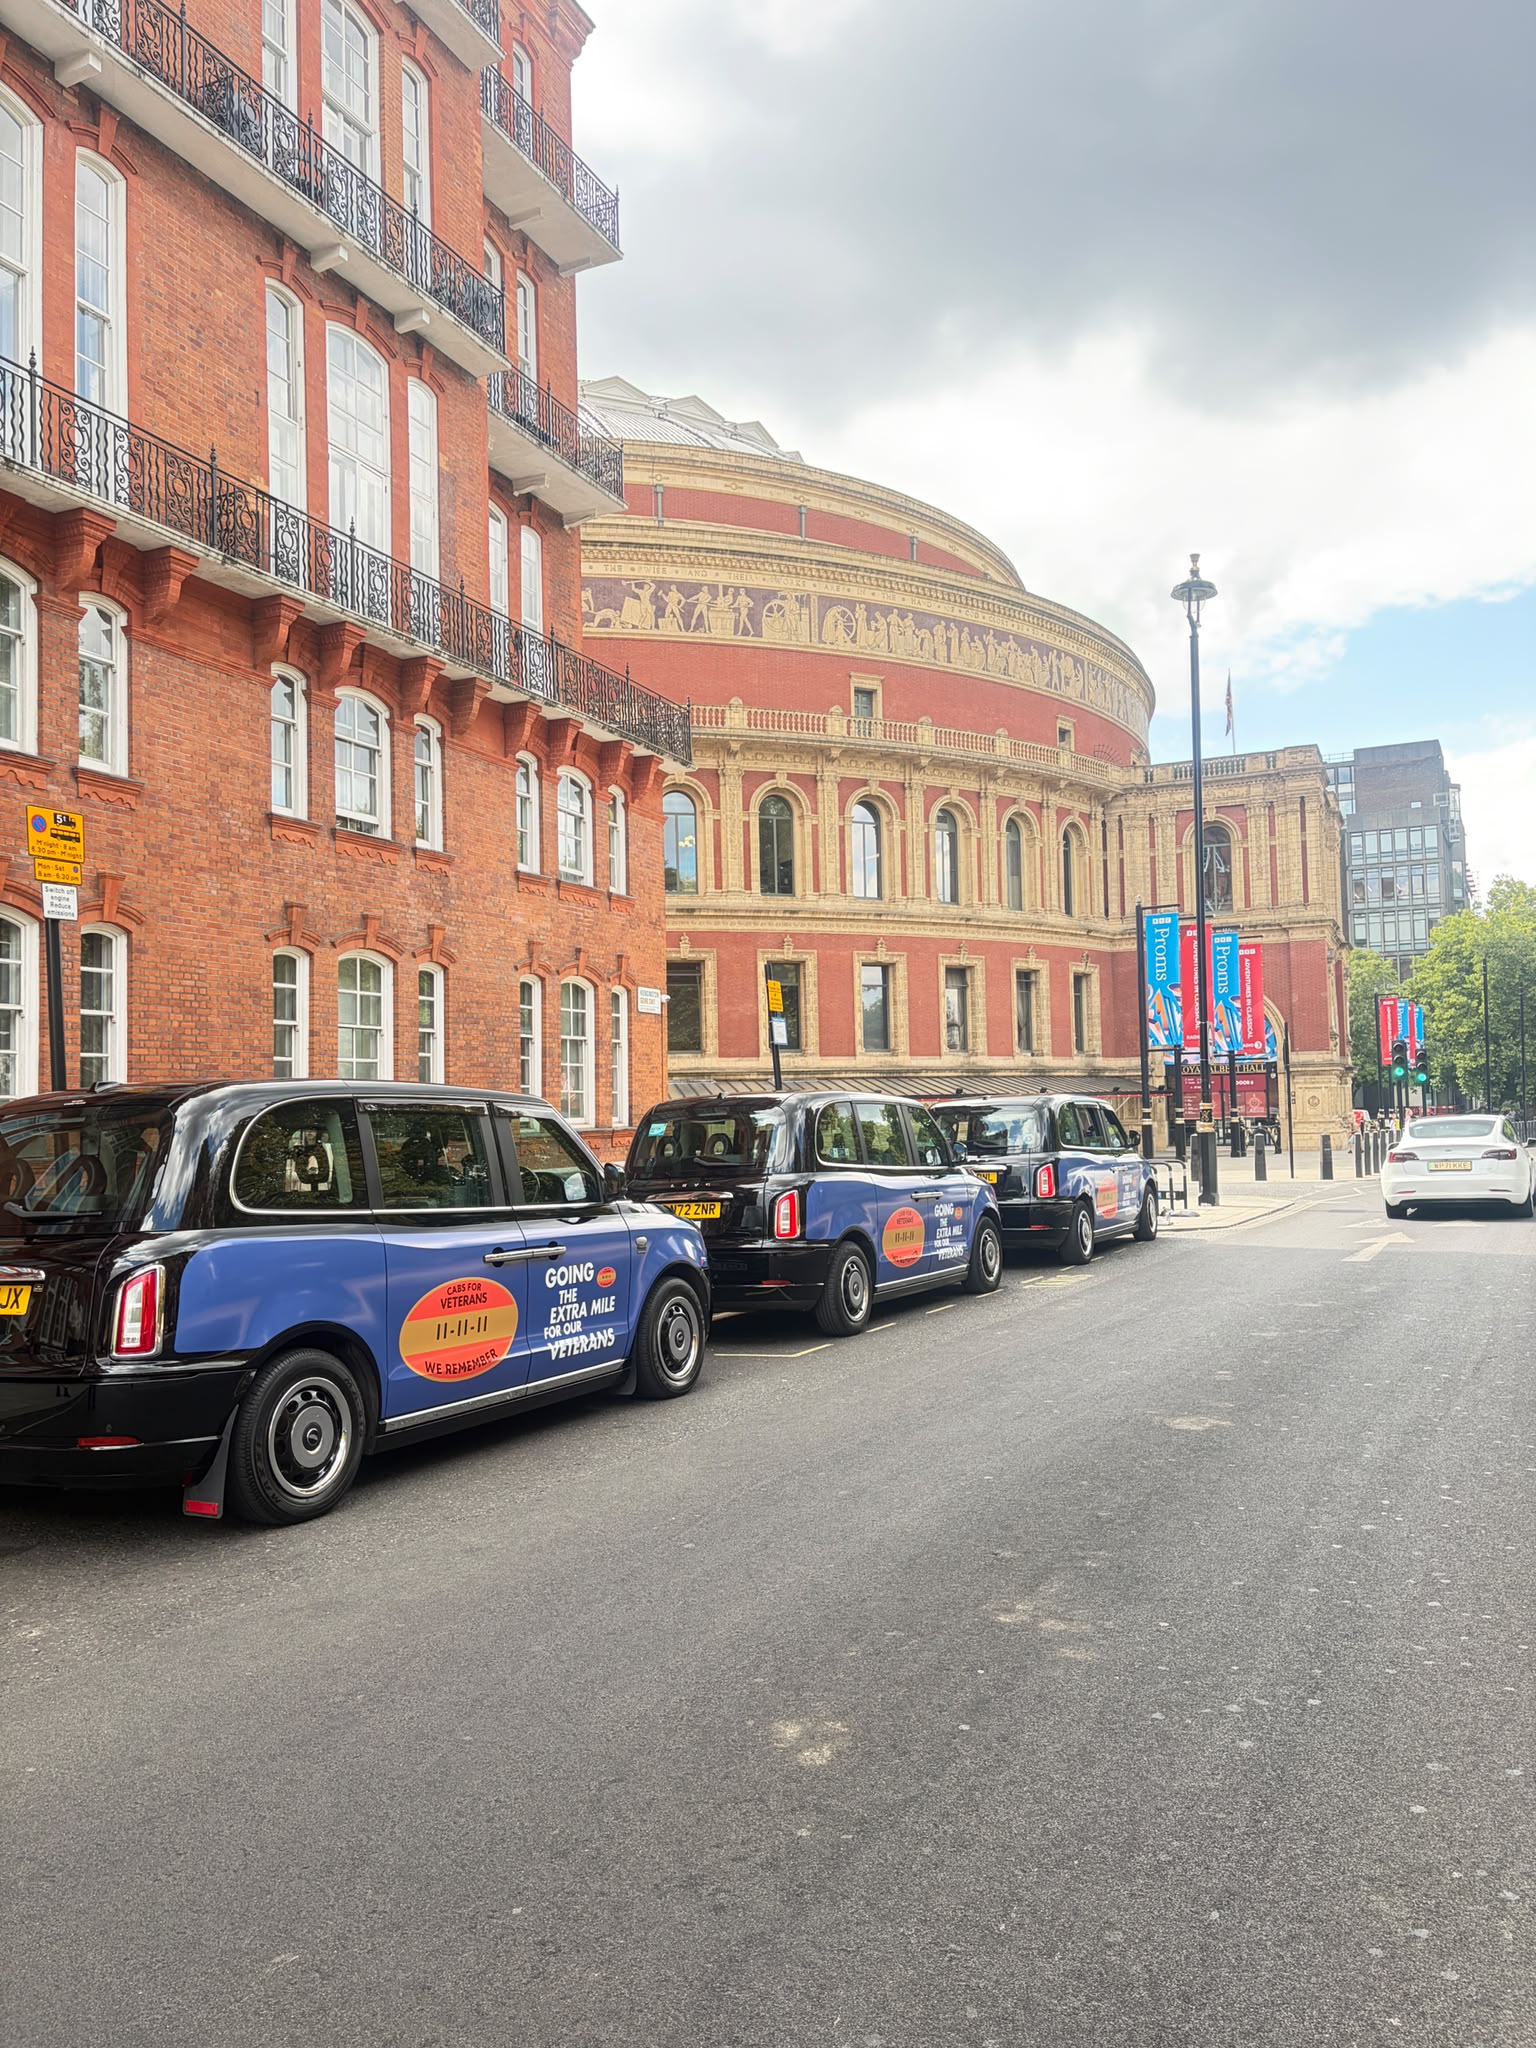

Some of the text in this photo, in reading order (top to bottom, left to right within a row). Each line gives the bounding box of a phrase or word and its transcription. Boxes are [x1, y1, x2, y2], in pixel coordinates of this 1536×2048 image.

[603, 564, 623, 572] THE
[687, 569, 708, 577] AND
[44, 885, 65, 894] Switch
[1154, 927, 1170, 981] Proms
[1216, 946, 1231, 994] Proms
[1244, 958, 1252, 998] ADVENTURES
[1209, 1064, 1241, 1073] ALBET
[1243, 1063, 1266, 1072] HALL
[694, 1203, 716, 1216] ZNR
[934, 1203, 954, 1217] GOING
[936, 1224, 963, 1239] EXTRA MILE
[544, 1262, 595, 1288] GOING
[447, 1282, 482, 1296] CABS FOR
[558, 1288, 578, 1305] THE
[440, 1292, 488, 1310] VETERANS
[550, 1296, 616, 1324] EXTRA MILE
[543, 1320, 582, 1340] FOR OUR
[547, 1328, 615, 1360] VETERANS
[424, 1348, 498, 1375] WE REMEMBER
